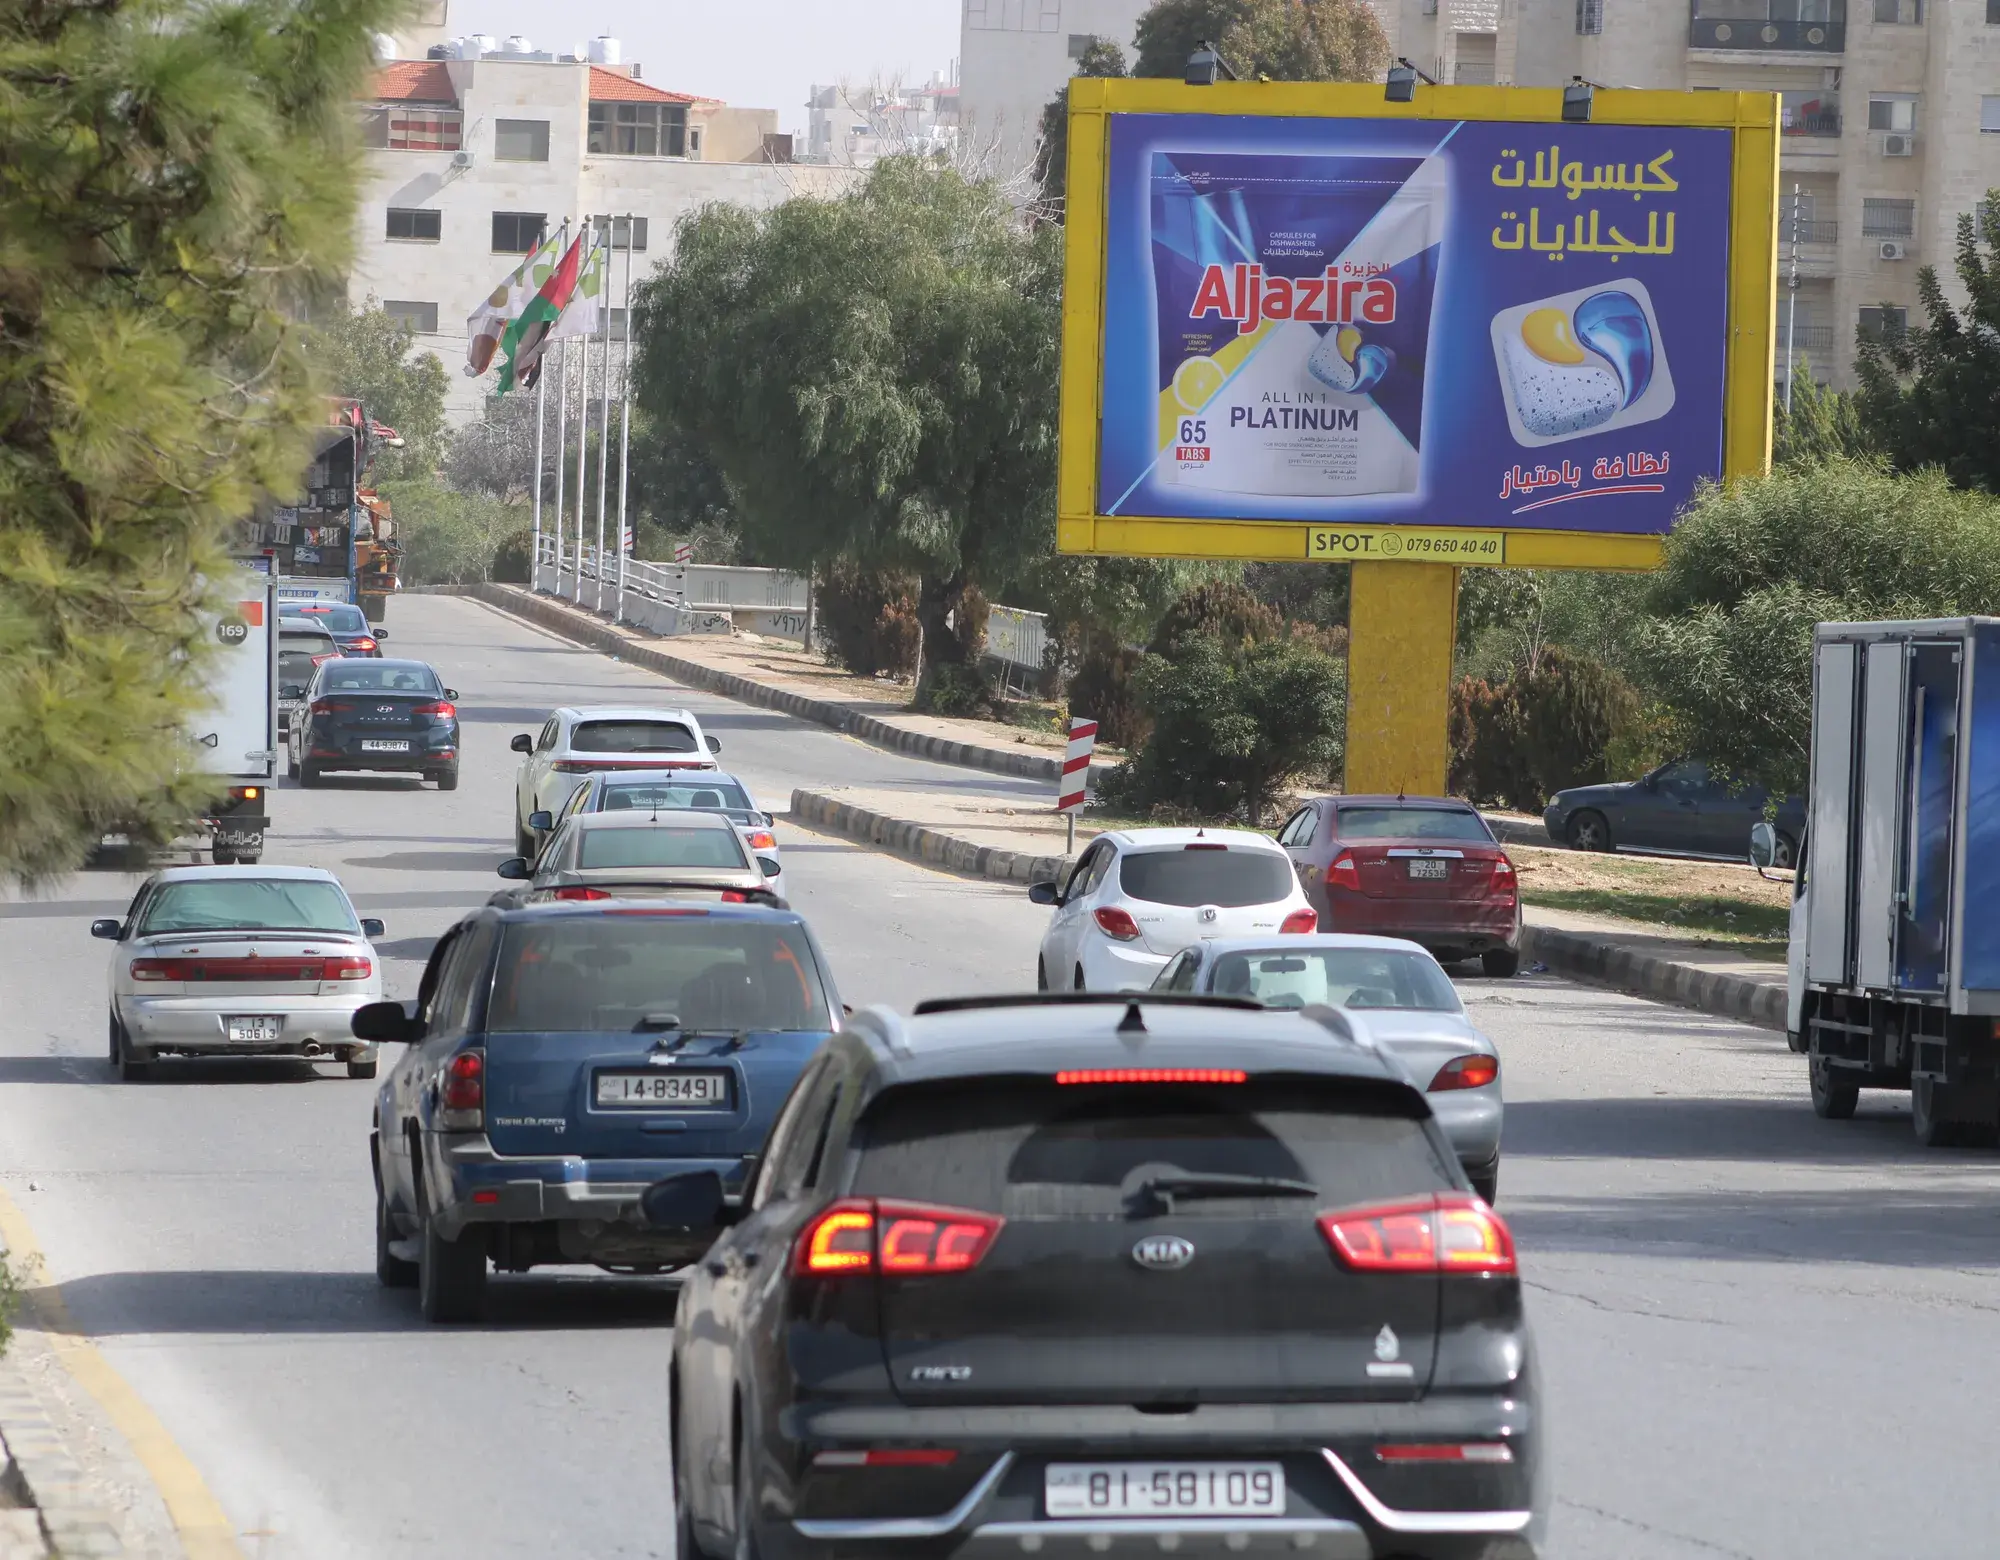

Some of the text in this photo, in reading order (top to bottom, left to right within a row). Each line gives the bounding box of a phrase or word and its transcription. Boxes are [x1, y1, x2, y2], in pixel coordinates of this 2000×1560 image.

[1492, 146, 1678, 201] كبسولات
[1492, 208, 1675, 262] للجلايات
[1263, 248, 1324, 257] كبسولات للجلايات
[1344, 262, 1389, 276] الجزيرة
[1190, 263, 1396, 335] Aljazira
[1262, 392, 1327, 404] ALL IN 1
[1230, 406, 1359, 431] PLATINUM
[1181, 420, 1206, 443] 65
[1180, 448, 1205, 460] TABS
[1500, 452, 1670, 498] نظافة بامتياز
[1316, 533, 1497, 553] SPOT 079 650 40 40
[220, 625, 244, 636] 169
[1417, 869, 1445, 877] 72536
[252, 1018, 265, 1028] 13
[240, 1029, 276, 1039] 50613
[1143, 1243, 1180, 1261] KIA
